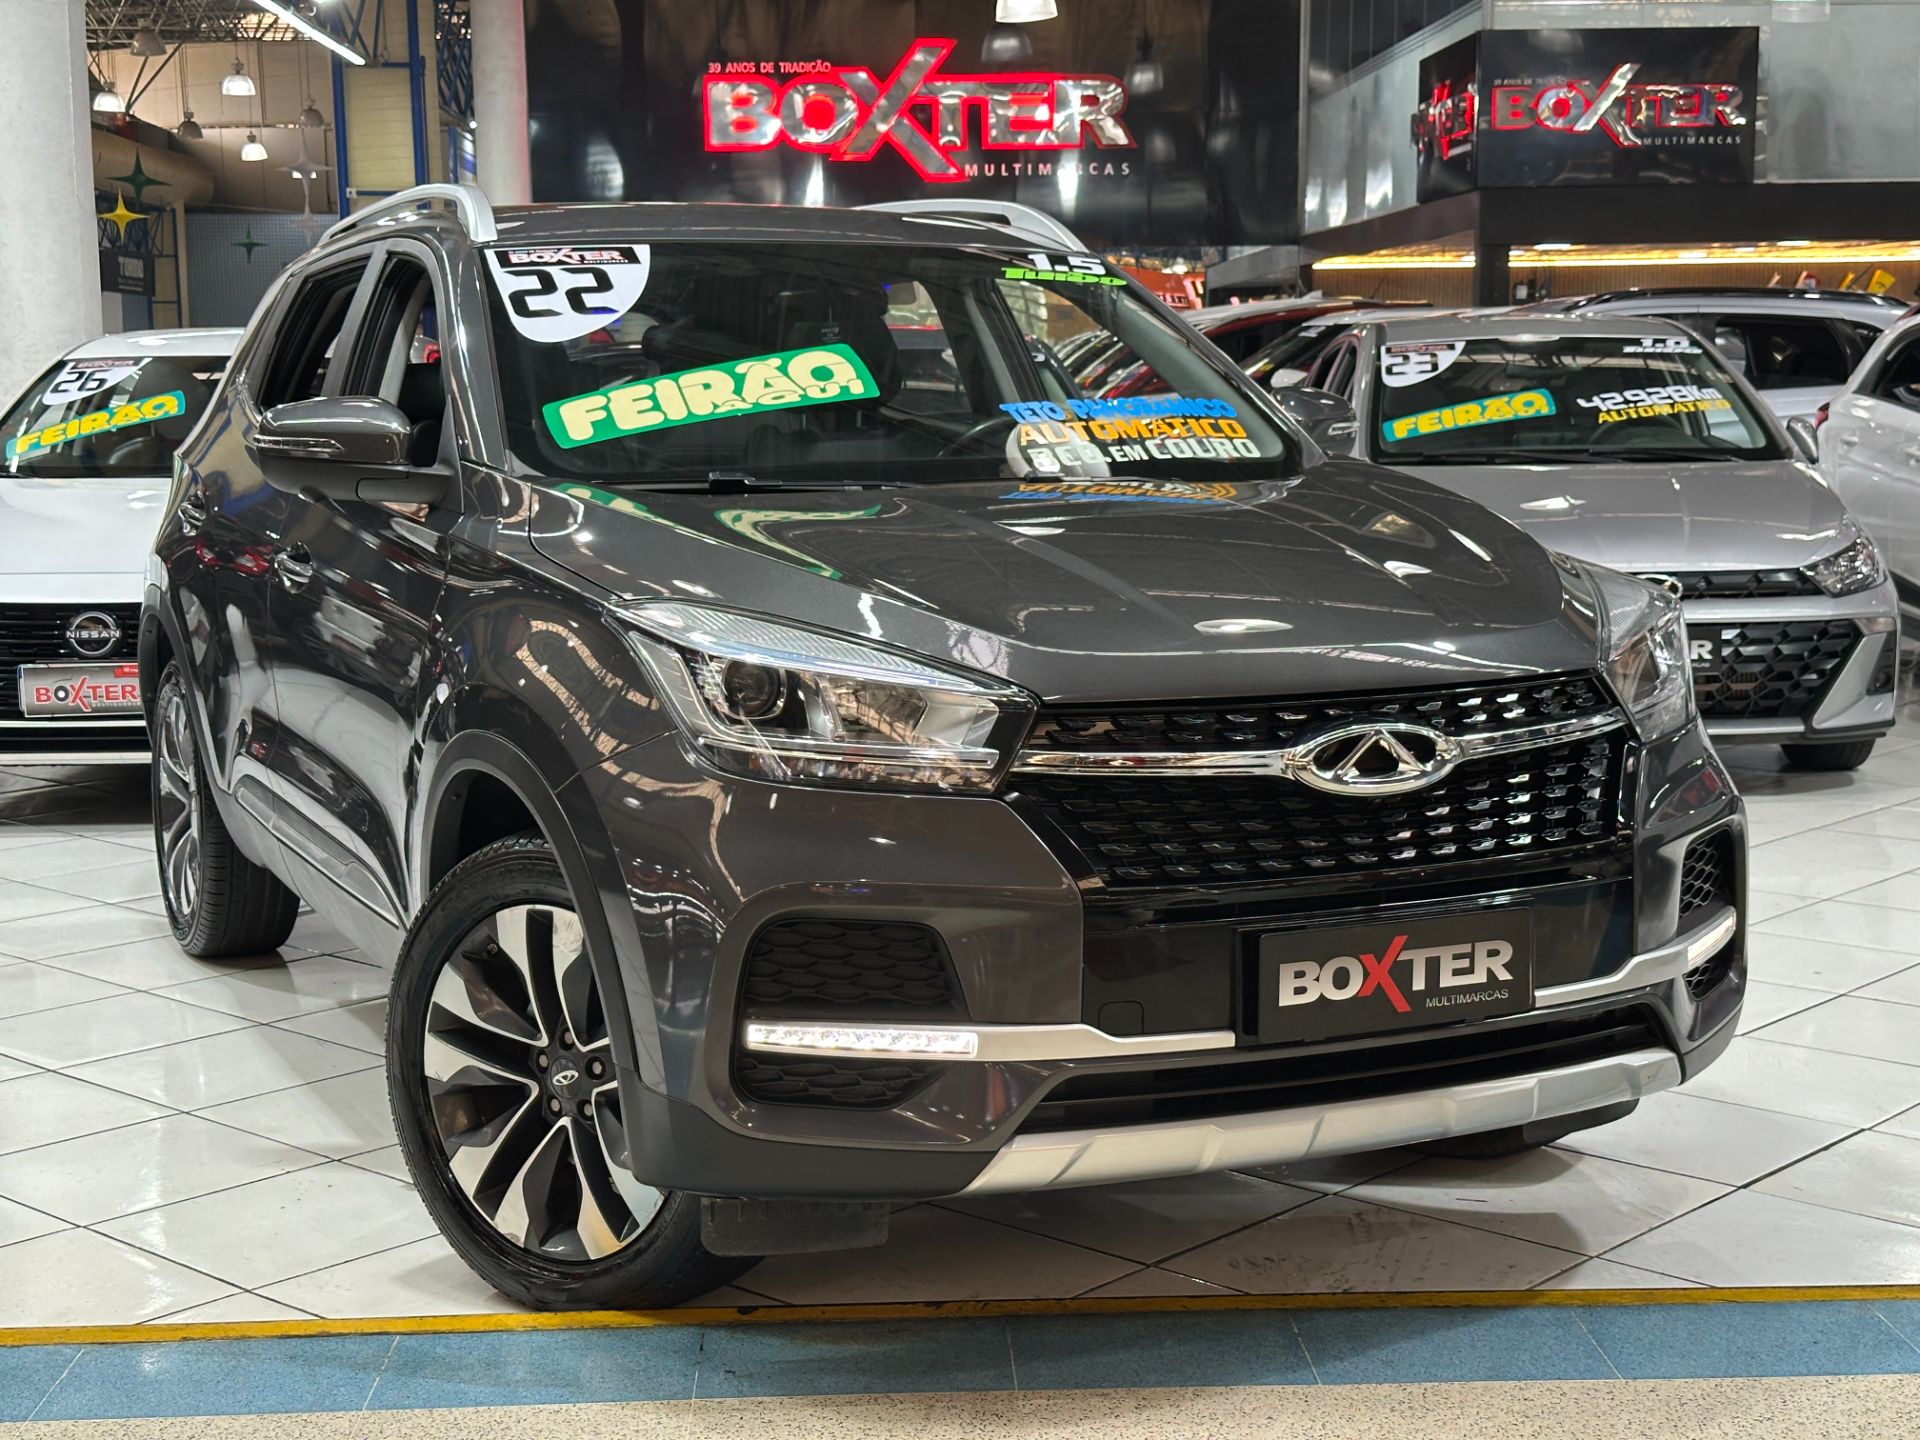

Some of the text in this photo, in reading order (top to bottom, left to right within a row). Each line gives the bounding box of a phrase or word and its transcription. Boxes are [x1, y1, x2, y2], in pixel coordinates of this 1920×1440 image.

[708, 59, 832, 73] 39 ANOS DE TRADIÇÃO
[703, 37, 1138, 182] BOXTER
[1491, 62, 1747, 148] BOXTER
[1642, 136, 1742, 145] MULTIMARCAS
[508, 248, 624, 264] BOXTER
[1028, 253, 1107, 275] 1.5
[503, 266, 620, 318] 22
[1386, 353, 1439, 375] 23
[50, 369, 109, 393] 26
[559, 350, 856, 441] FEIRÃO
[16, 395, 178, 454] FEIRÃO
[999, 401, 1066, 424] TETO
[1393, 391, 1548, 439] FEIRÃO
[1108, 445, 1149, 462] EM
[1145, 438, 1261, 460] COURO
[66, 630, 120, 638] NISSAN
[34, 675, 140, 712] BOXTER
[1278, 935, 1514, 1013] BOXTER
[1425, 989, 1509, 1008] MULTIMARCAS
